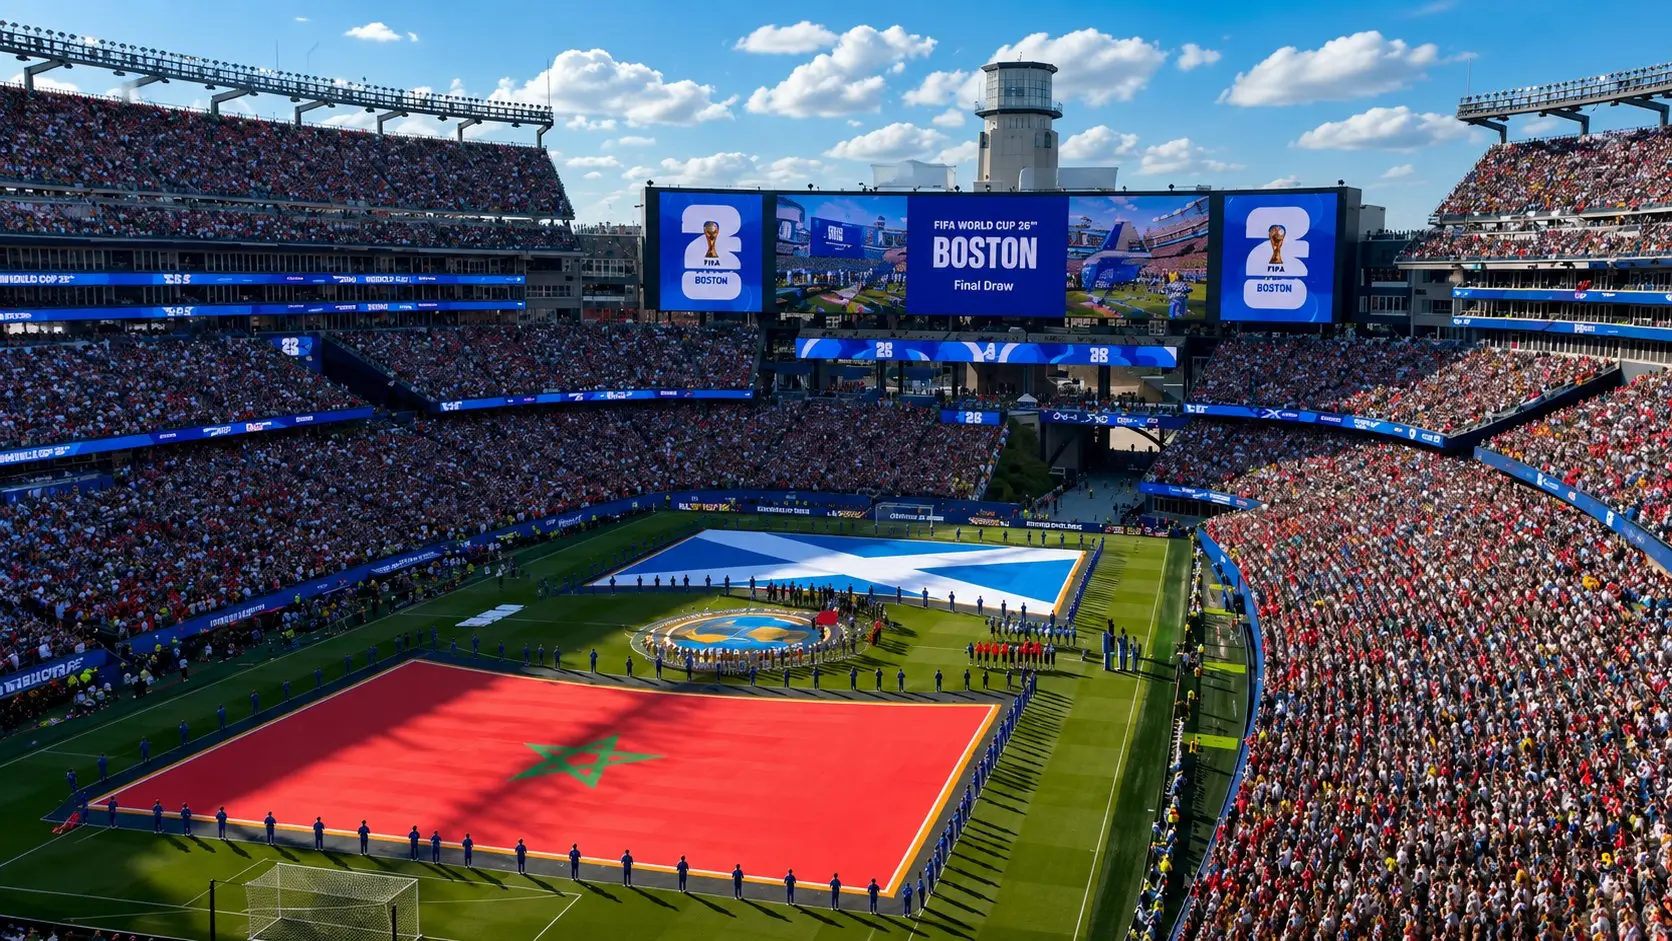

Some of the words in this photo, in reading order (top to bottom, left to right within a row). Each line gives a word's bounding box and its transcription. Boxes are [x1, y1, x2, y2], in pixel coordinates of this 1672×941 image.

[934, 220, 956, 230] FIFA
[957, 220, 993, 230] WORLD
[995, 220, 1016, 230] CUP
[932, 236, 1038, 269] BOSTON
[694, 276, 728, 284] BOSTON
[954, 279, 981, 291] Final
[984, 280, 1014, 291] Draw
[1256, 283, 1292, 293] BOSTON
